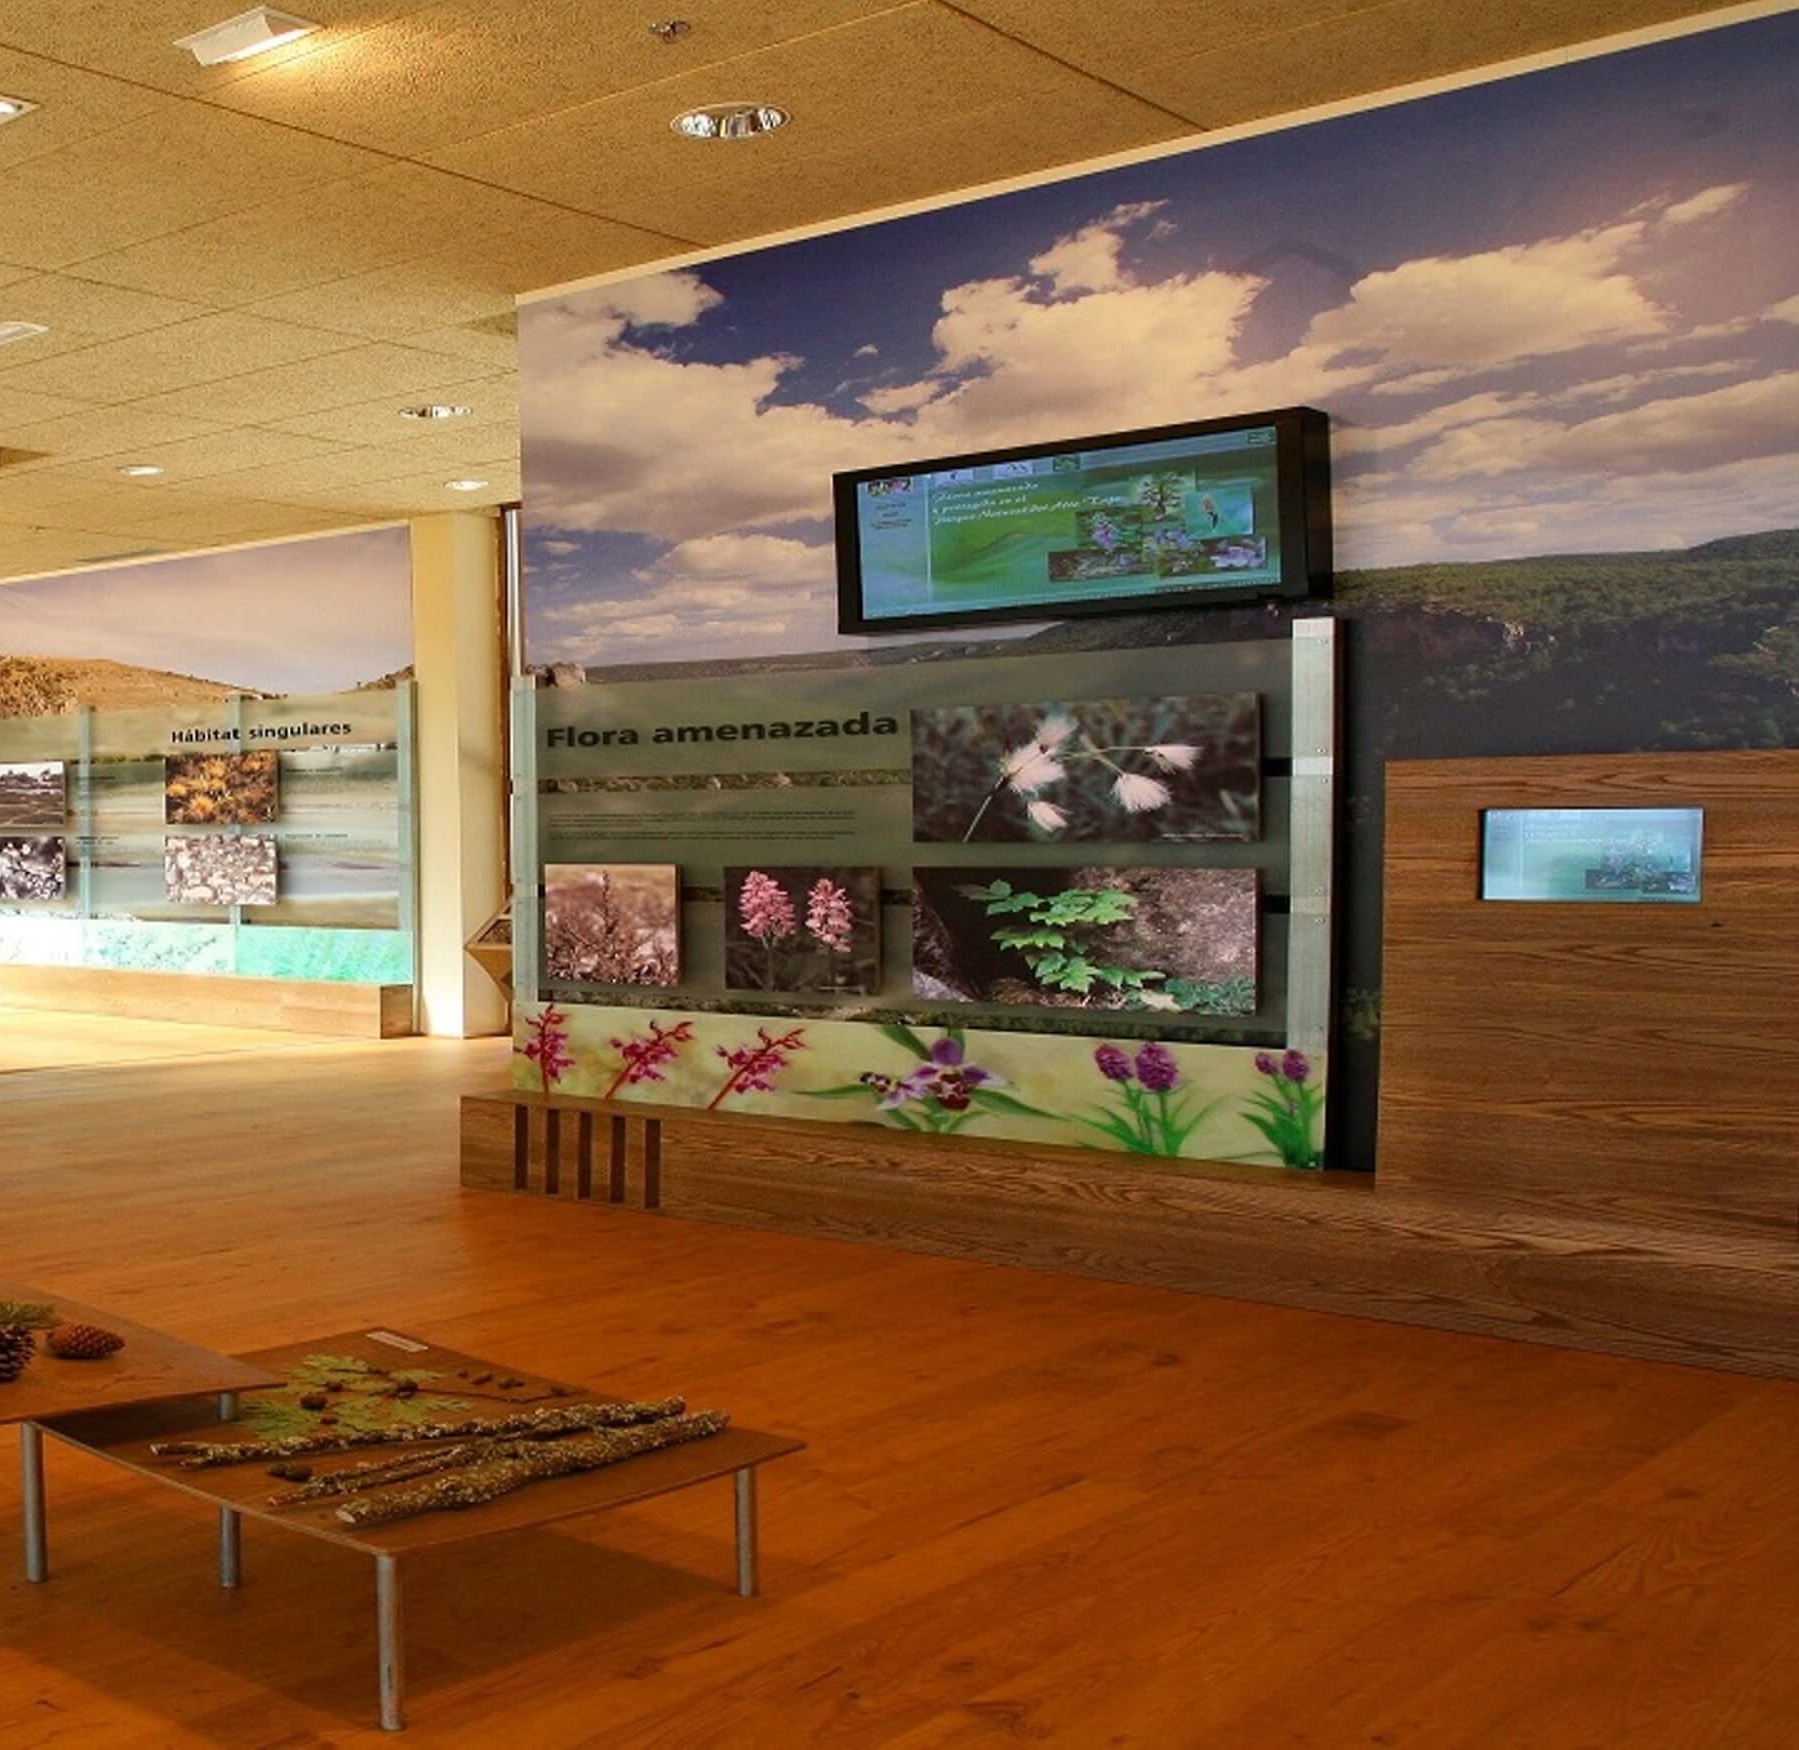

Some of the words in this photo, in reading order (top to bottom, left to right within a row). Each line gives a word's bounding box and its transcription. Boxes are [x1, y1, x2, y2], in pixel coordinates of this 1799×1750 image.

[171, 728, 240, 743] Hábitat
[249, 722, 352, 740] singulares
[546, 726, 639, 748] Flora
[652, 711, 898, 744] amenazada
